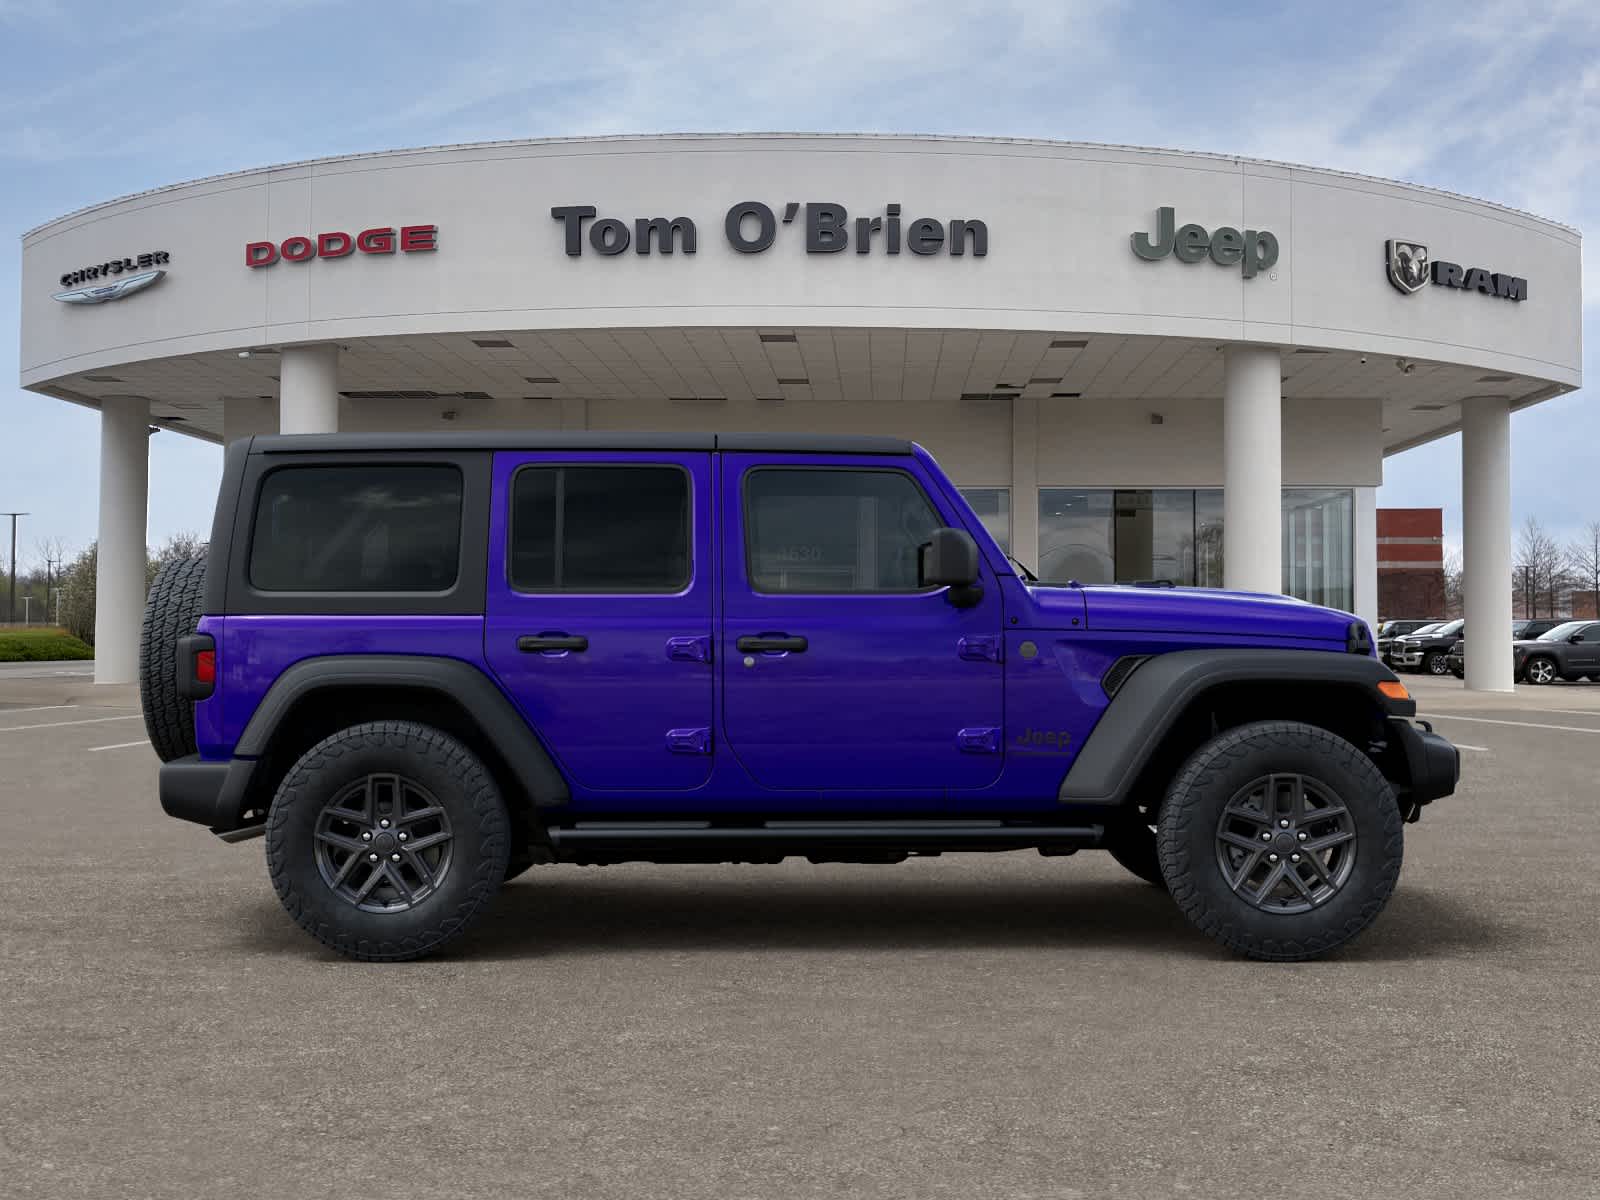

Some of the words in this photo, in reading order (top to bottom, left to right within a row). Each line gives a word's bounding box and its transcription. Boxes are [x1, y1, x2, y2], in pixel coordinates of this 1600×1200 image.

[246, 225, 438, 269] DODGE
[551, 206, 697, 257] Tom
[725, 202, 988, 257] O'Brien
[1131, 207, 1279, 279] Jeep
[60, 251, 170, 287] CHRYSLER
[1431, 261, 1527, 301] RAM
[1016, 727, 1072, 751] Jeep
